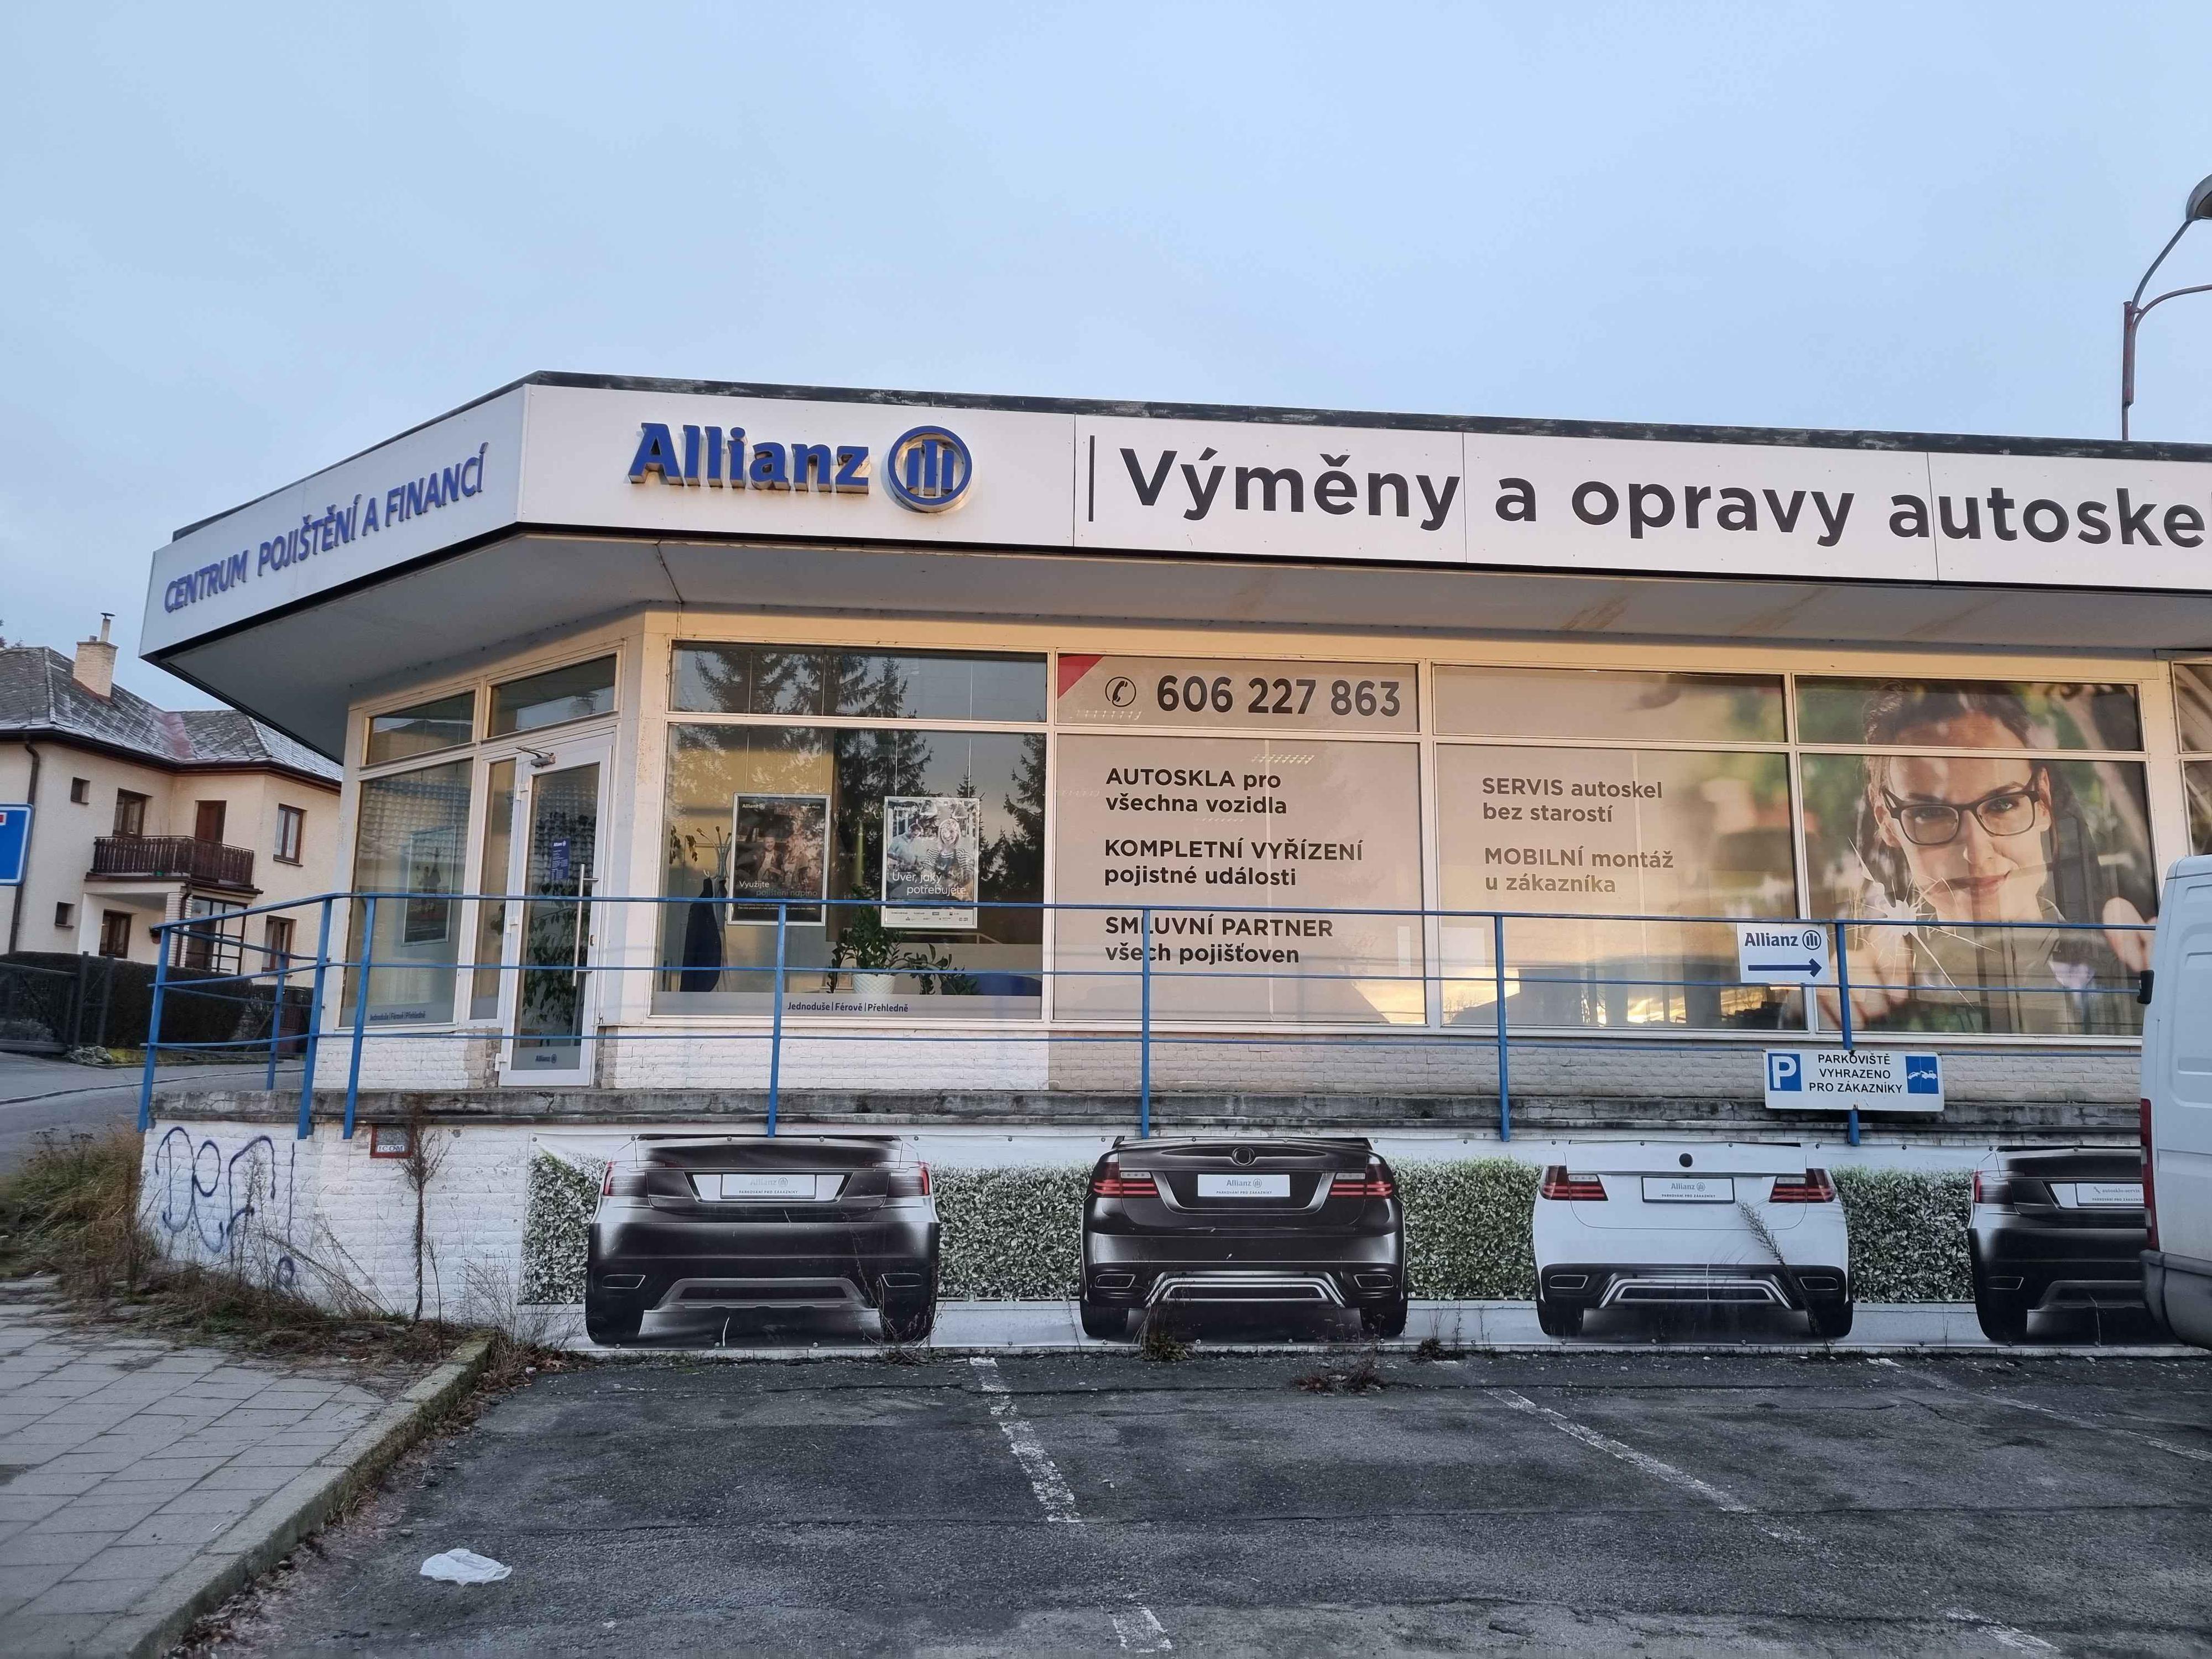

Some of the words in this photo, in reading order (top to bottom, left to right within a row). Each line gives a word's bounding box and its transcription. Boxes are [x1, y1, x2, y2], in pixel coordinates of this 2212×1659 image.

[628, 422, 870, 494] Allianz
[1119, 447, 1460, 531] Výměny
[1495, 477, 1537, 522] a
[1571, 481, 1855, 547] opravy
[1888, 486, 2212, 549] autoske
[164, 550, 249, 613] CENTRUM
[257, 494, 362, 576] POJIŠTĚNÍ
[362, 498, 379, 536] A
[384, 442, 489, 527] FINANCÍ
[1157, 675, 1233, 713] 606
[1248, 677, 1316, 715] 227
[1331, 680, 1401, 717] 863
[1106, 768, 1235, 787] AUTOSKLA
[1243, 774, 1282, 791] pro
[1482, 778, 1563, 796] SERVIS
[1571, 781, 1663, 799] autoskel
[1106, 793, 1198, 812] všechna
[1207, 796, 1287, 814] vozidla
[1483, 802, 1522, 820] bez
[1530, 804, 1614, 822] starostí
[1105, 837, 1243, 859] KOMPLETNÍ
[1251, 838, 1364, 861] VYŘÍZENÍ
[1485, 846, 1584, 867] MOBILNÍ
[1592, 851, 1673, 869] montáž
[739, 880, 770, 889] Využijte
[892, 869, 917, 883] Úvěr,
[920, 872, 942, 884] jaký
[1105, 865, 1197, 886] pojistné
[1205, 867, 1296, 886] události
[1486, 878, 1498, 890] u
[1506, 874, 1616, 893] zákazníka
[1222, 918, 1333, 937] PARTNER
[1744, 932, 1799, 947] Allianz
[1105, 942, 1171, 961] všech
[1179, 943, 1299, 965] pojišťoven
[787, 1001, 830, 1011] Jednoduše
[835, 1003, 863, 1011] Férově
[868, 1003, 909, 1012] Přehledně
[1818, 1053, 1891, 1065] PARKOVIŠTĚ
[1772, 1056, 1797, 1089] P
[1819, 1068, 1891, 1079] VYHRAZENO
[1809, 1082, 1834, 1092] PRO
[1837, 1081, 1903, 1093] ZÁKAZNÍKY
